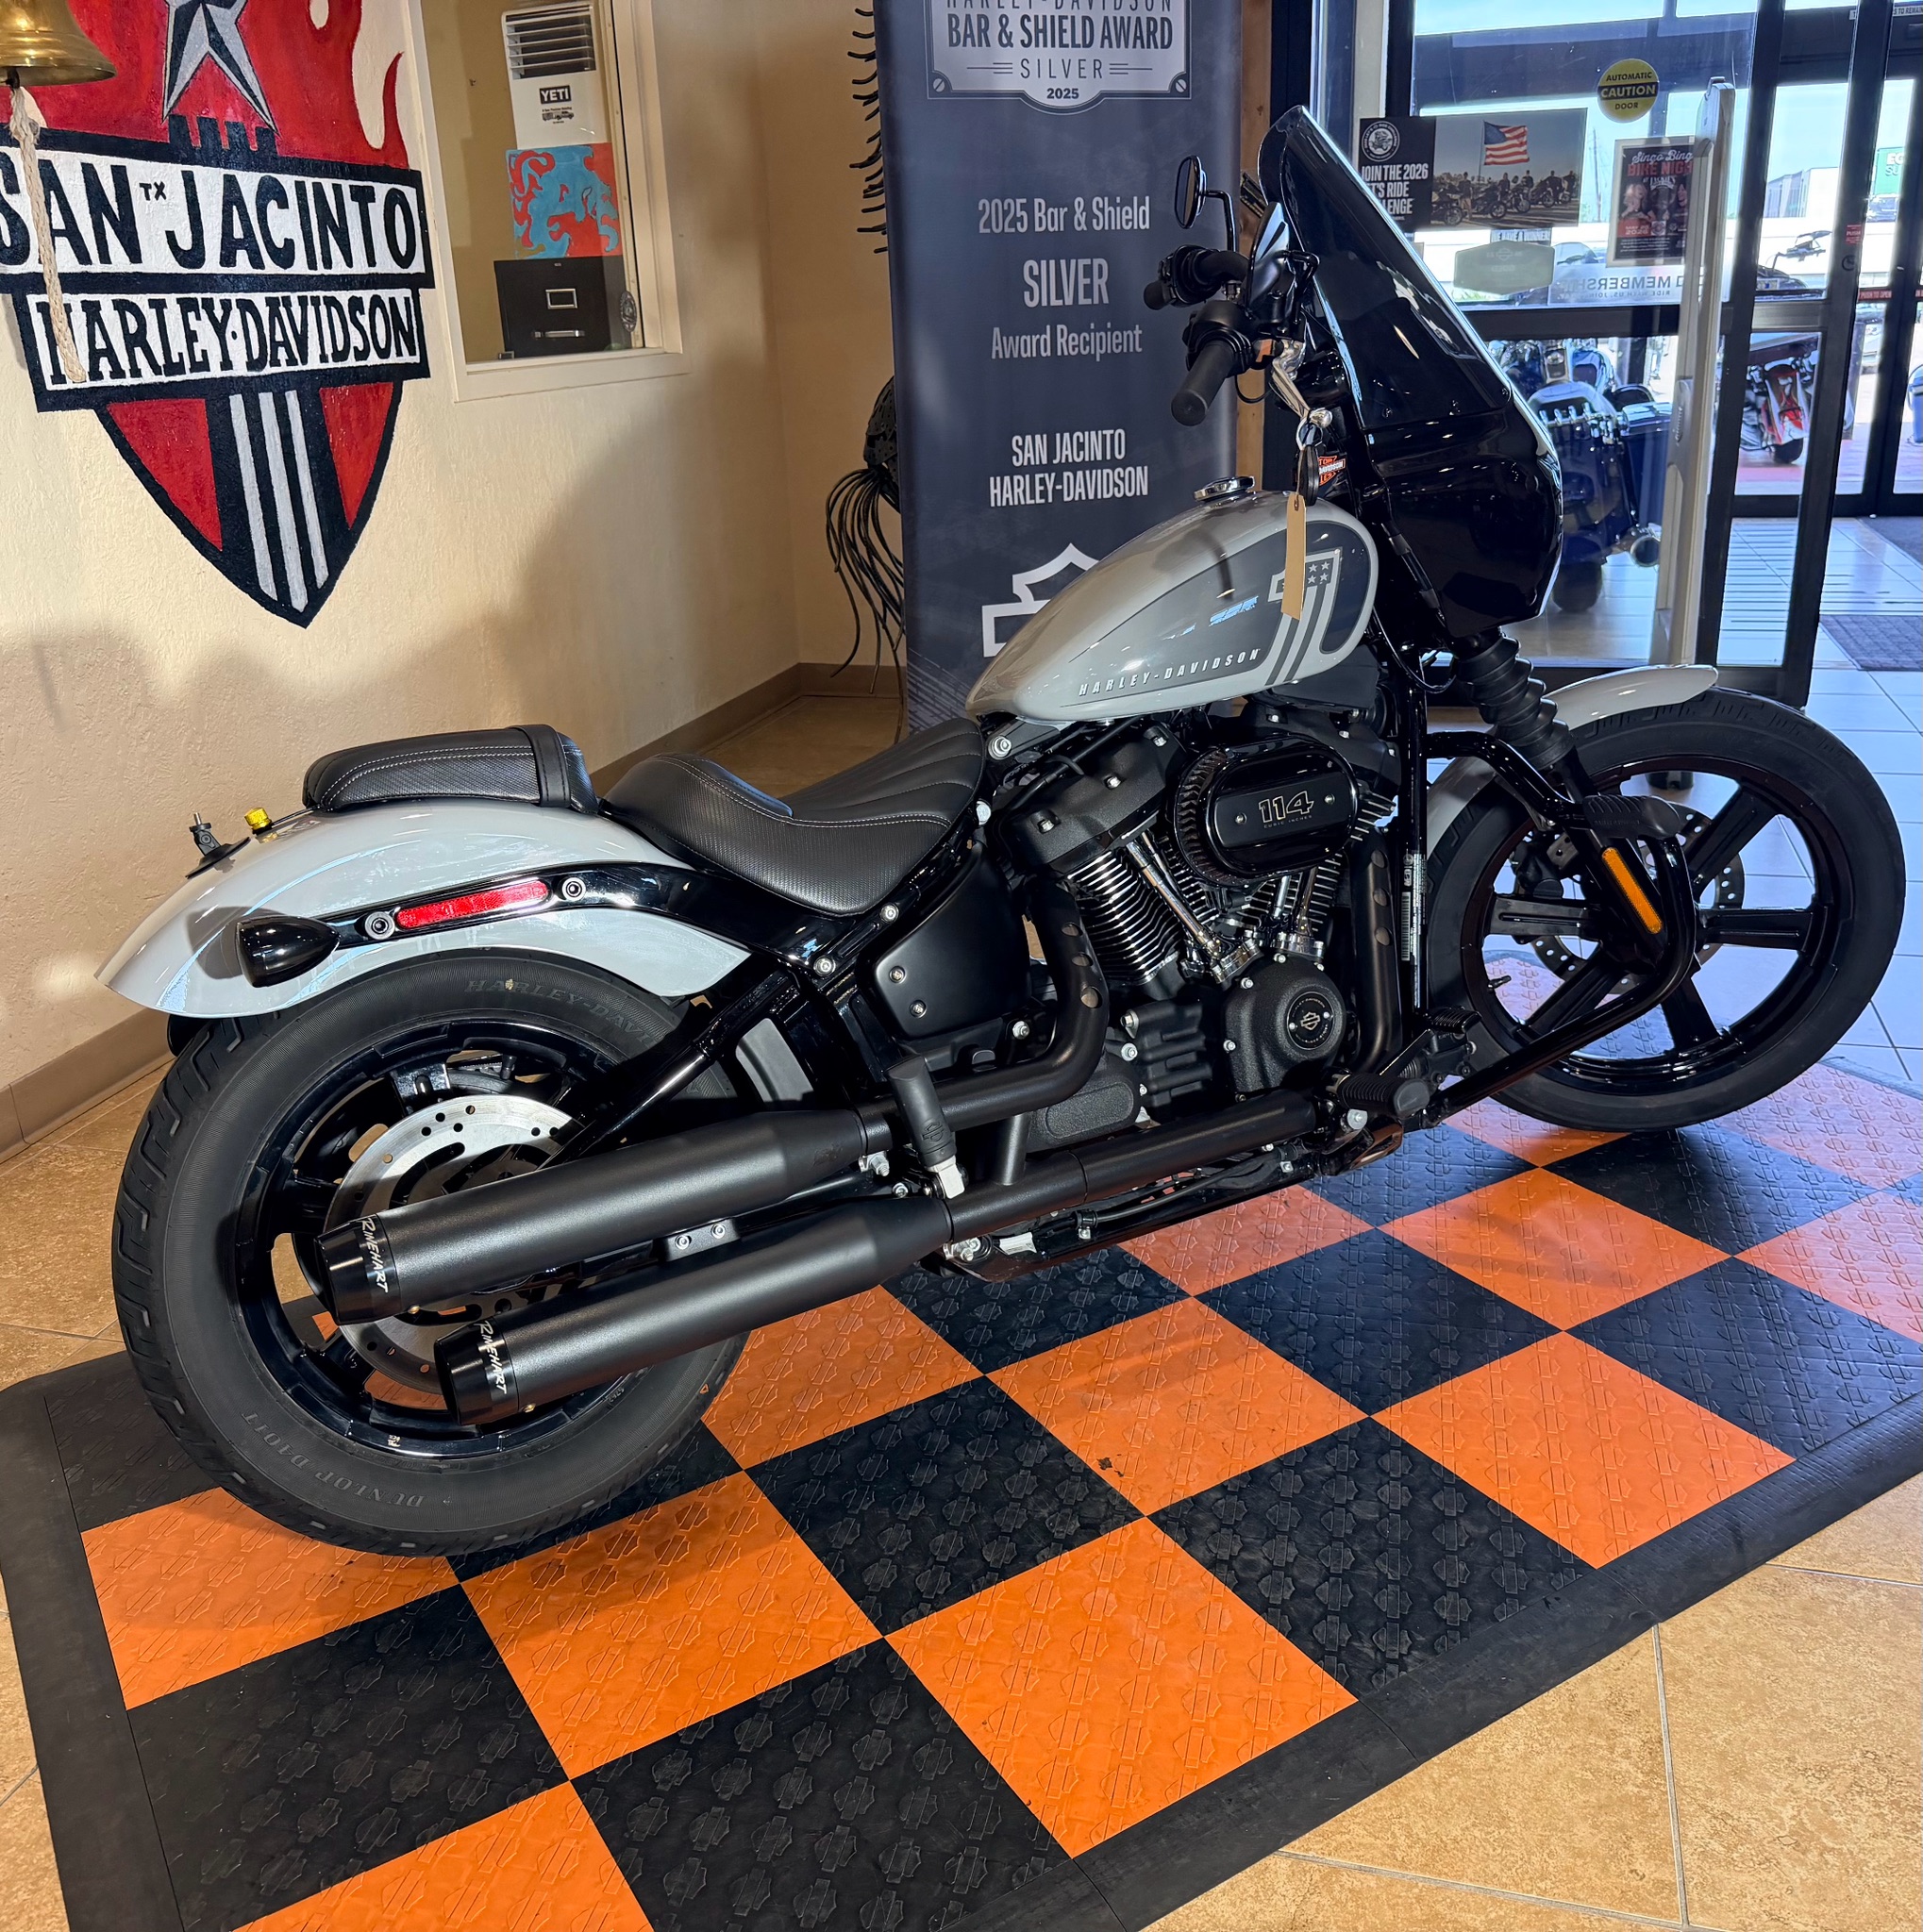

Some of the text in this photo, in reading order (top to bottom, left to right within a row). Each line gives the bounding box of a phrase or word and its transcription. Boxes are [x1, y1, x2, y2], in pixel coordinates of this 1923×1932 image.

[946, 13, 1173, 50] BAR & SHIELD AWARD
[1020, 58, 1103, 79] SILVER
[1606, 72, 1652, 82] AUTOMATIC
[541, 88, 570, 102] YETI
[1046, 87, 1079, 100] 2025
[1600, 85, 1656, 98] CAUTION
[1614, 102, 1639, 110] DOOR
[139, 181, 167, 201] TX
[1362, 163, 1429, 182] JOIN THE 2026
[1386, 181, 1410, 198] RIDE
[0, 151, 416, 272] SAN JACINTO
[978, 195, 1150, 234] 2025 Bar & Shield
[1023, 258, 1110, 308] SILVER
[991, 321, 1143, 362] Award Recipient
[1012, 428, 1126, 467] SAN JACINTO
[989, 465, 1148, 508] HARLEY-DAVIDSON
[1079, 648, 1260, 696] HARLEY-DAVIDSON
[1258, 791, 1314, 824] 114
[358, 1216, 390, 1293] RINEHART
[473, 1320, 508, 1395] RINEHART
[314, 1470, 425, 1508] DUNLOP
